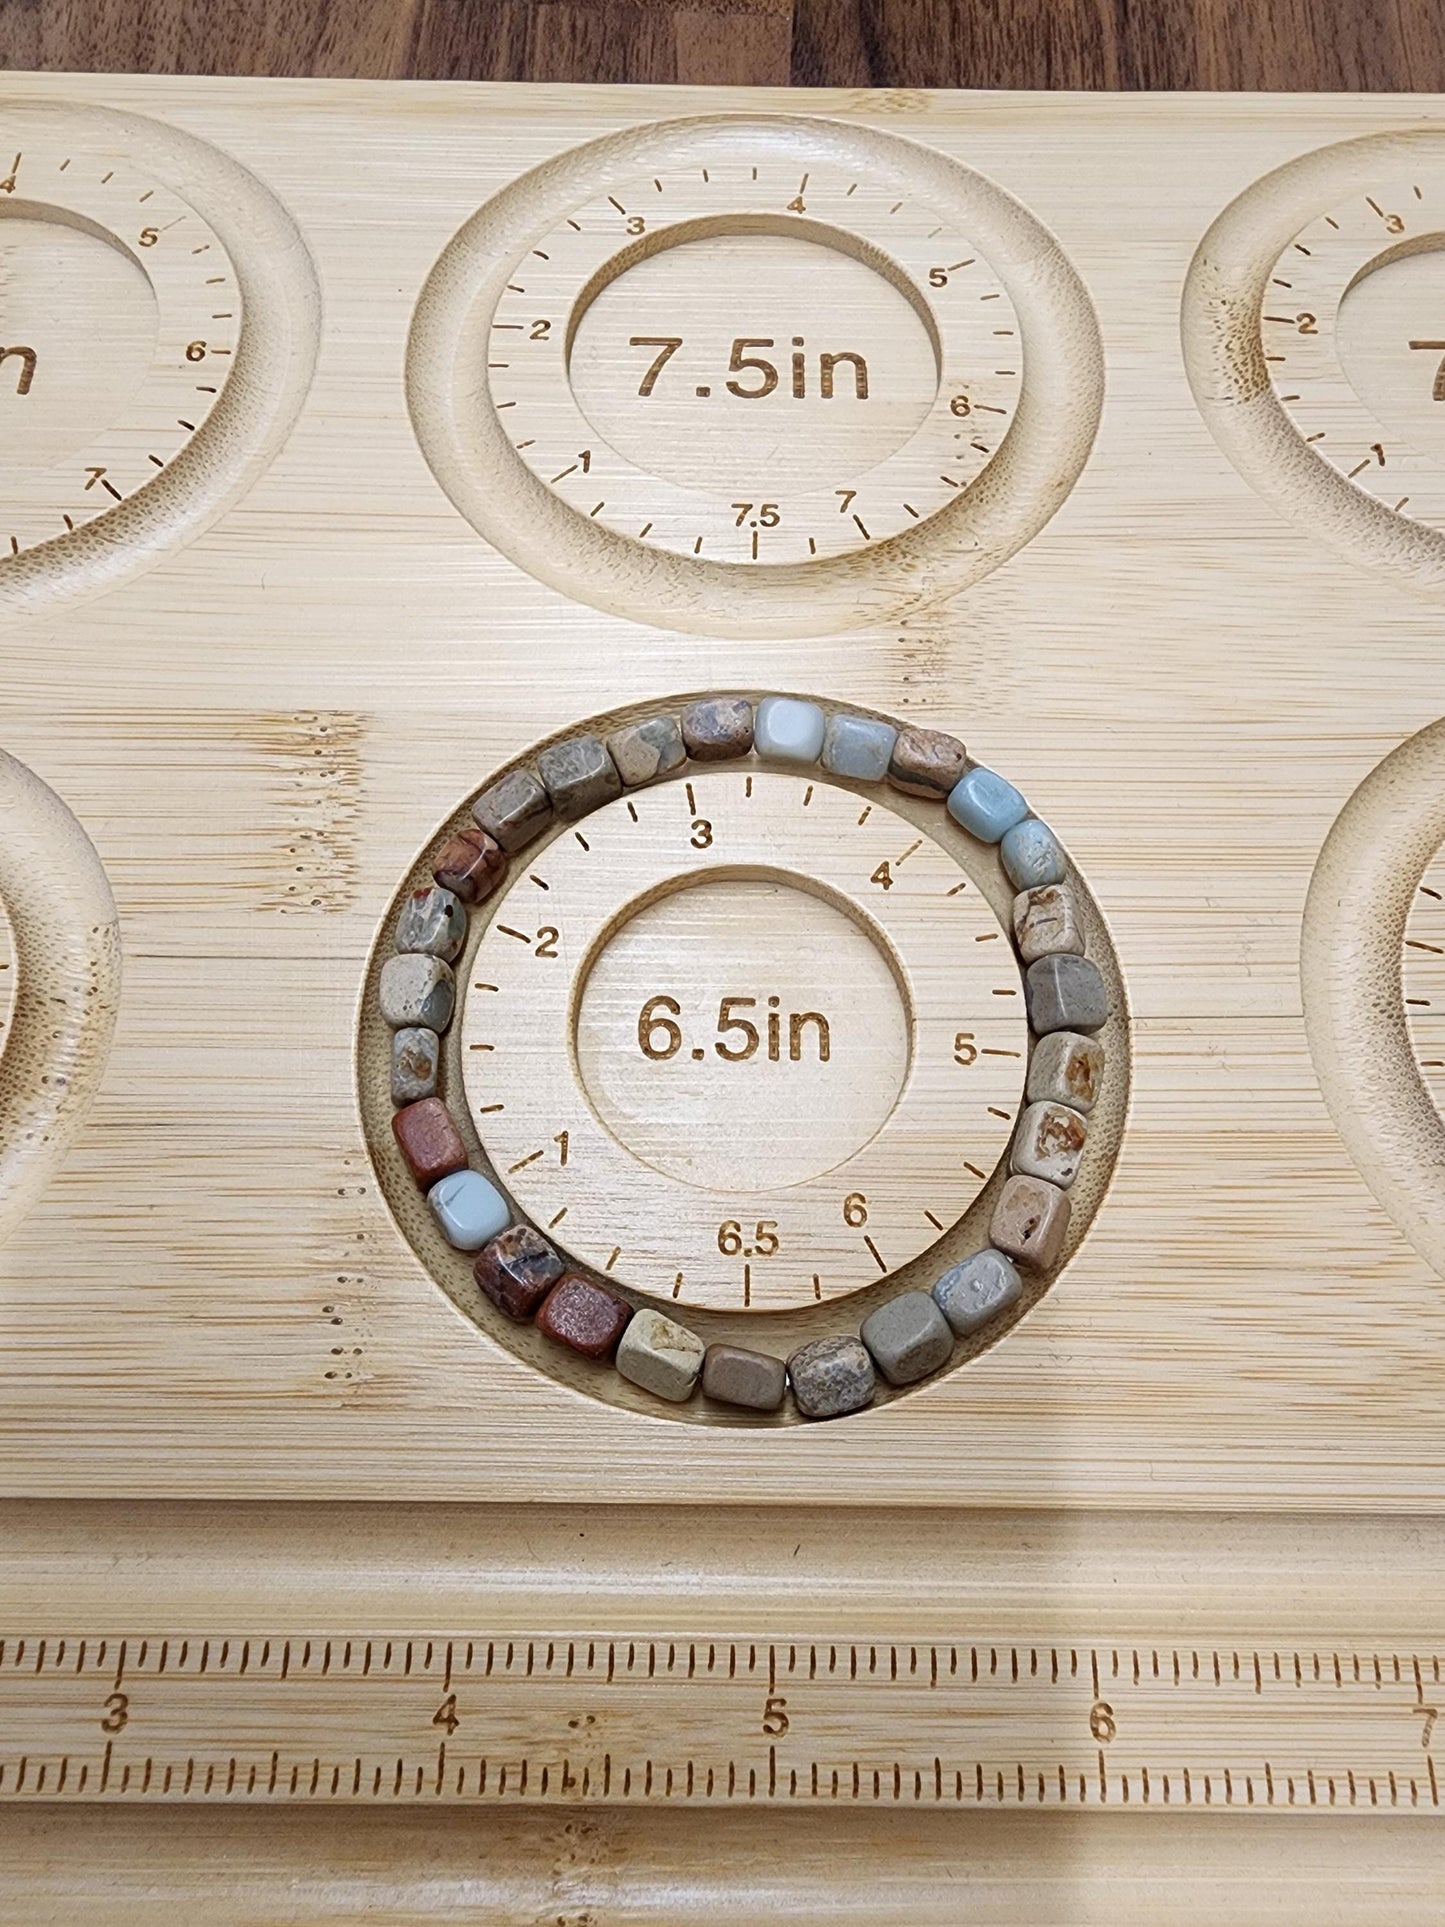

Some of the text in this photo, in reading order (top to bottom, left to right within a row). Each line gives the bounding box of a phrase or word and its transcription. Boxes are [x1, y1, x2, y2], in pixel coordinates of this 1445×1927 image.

[0, 175, 16, 193] 4
[787, 196, 806, 213] 4
[626, 217, 646, 235] 3
[1386, 214, 1405, 234] 3
[139, 227, 159, 247] 5
[929, 268, 948, 287] 5
[529, 320, 552, 341] 2
[1296, 312, 1318, 334] 2
[185, 341, 207, 362] 6
[629, 336, 869, 400] 7.5in
[950, 395, 971, 417] 6
[578, 450, 592, 473] 1
[1371, 443, 1386, 467] 1
[85, 467, 107, 490] 7
[835, 491, 857, 511] 7
[731, 504, 780, 527] 7.5
[690, 820, 713, 849] 3
[870, 861, 893, 889] 4
[535, 926, 560, 957] 2
[637, 995, 832, 1062] 6.5in
[953, 1033, 977, 1065] 5
[555, 1130, 569, 1165] 1
[843, 1194, 868, 1228] 6
[717, 1220, 780, 1257] 6.5
[101, 1693, 129, 1734] 3
[432, 1694, 459, 1735] 4
[763, 1698, 790, 1738] 5
[1089, 1702, 1116, 1743] 6
[1413, 1707, 1438, 1747] 7
